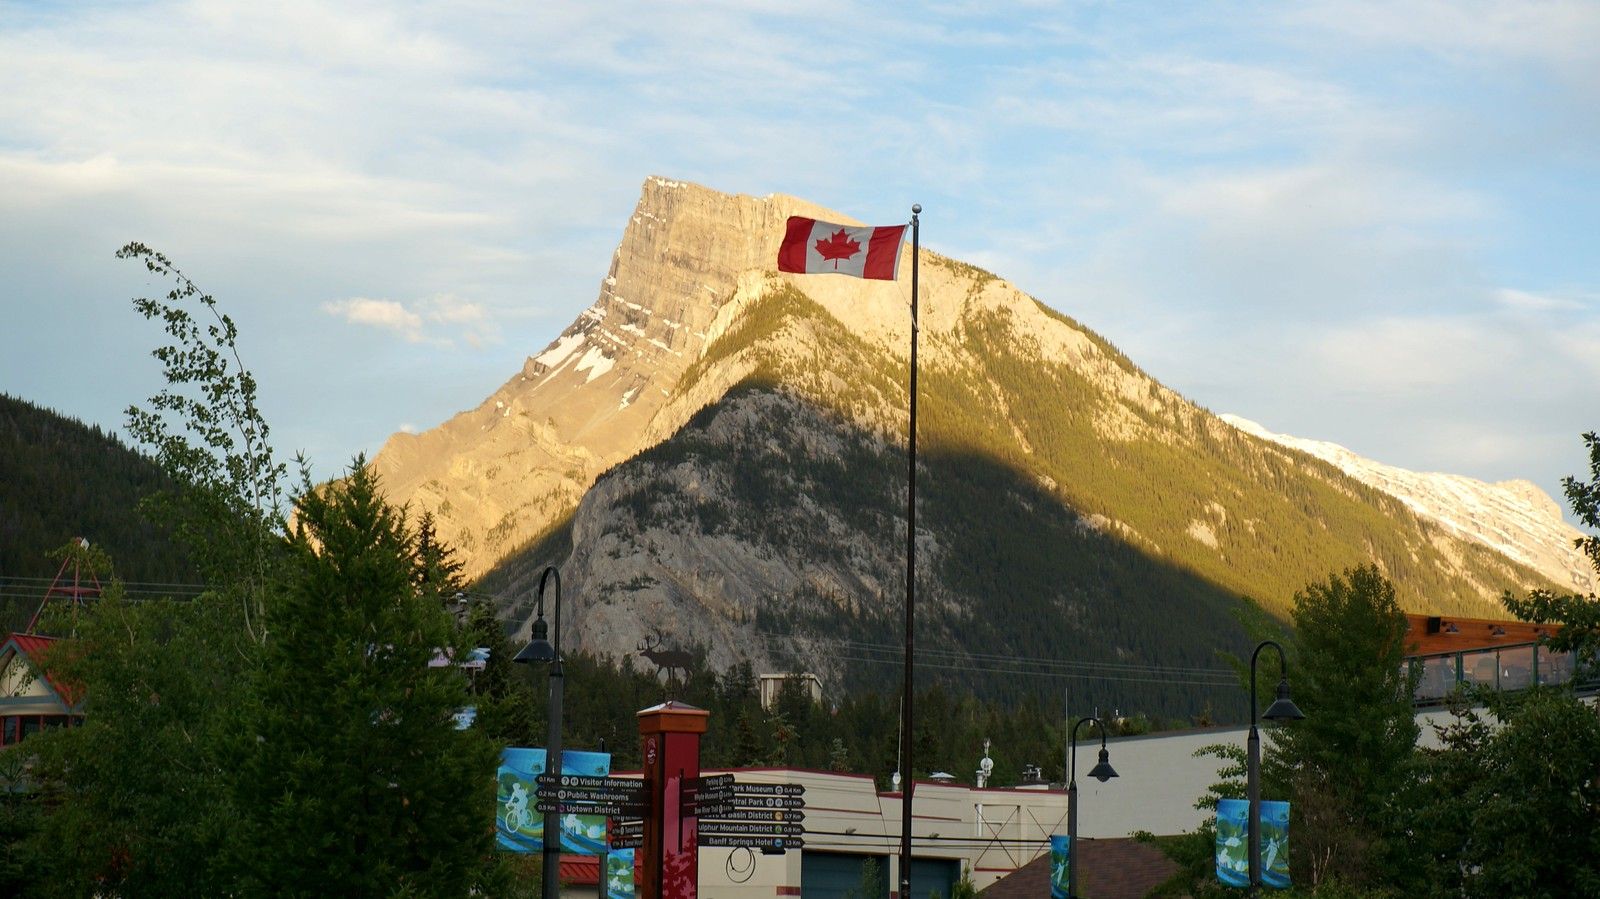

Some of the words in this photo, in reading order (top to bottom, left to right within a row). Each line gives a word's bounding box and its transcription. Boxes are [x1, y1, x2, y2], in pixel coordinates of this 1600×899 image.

[580, 778, 602, 786] Visitor
[604, 779, 643, 788] Information
[567, 791, 588, 799] Public
[590, 792, 629, 801] Washrooms
[566, 805, 593, 813] Uptown
[594, 806, 621, 814] District
[748, 811, 773, 819] District
[698, 823, 719, 832] ulphur
[709, 837, 727, 845] Banff
[728, 838, 754, 847] Springs
